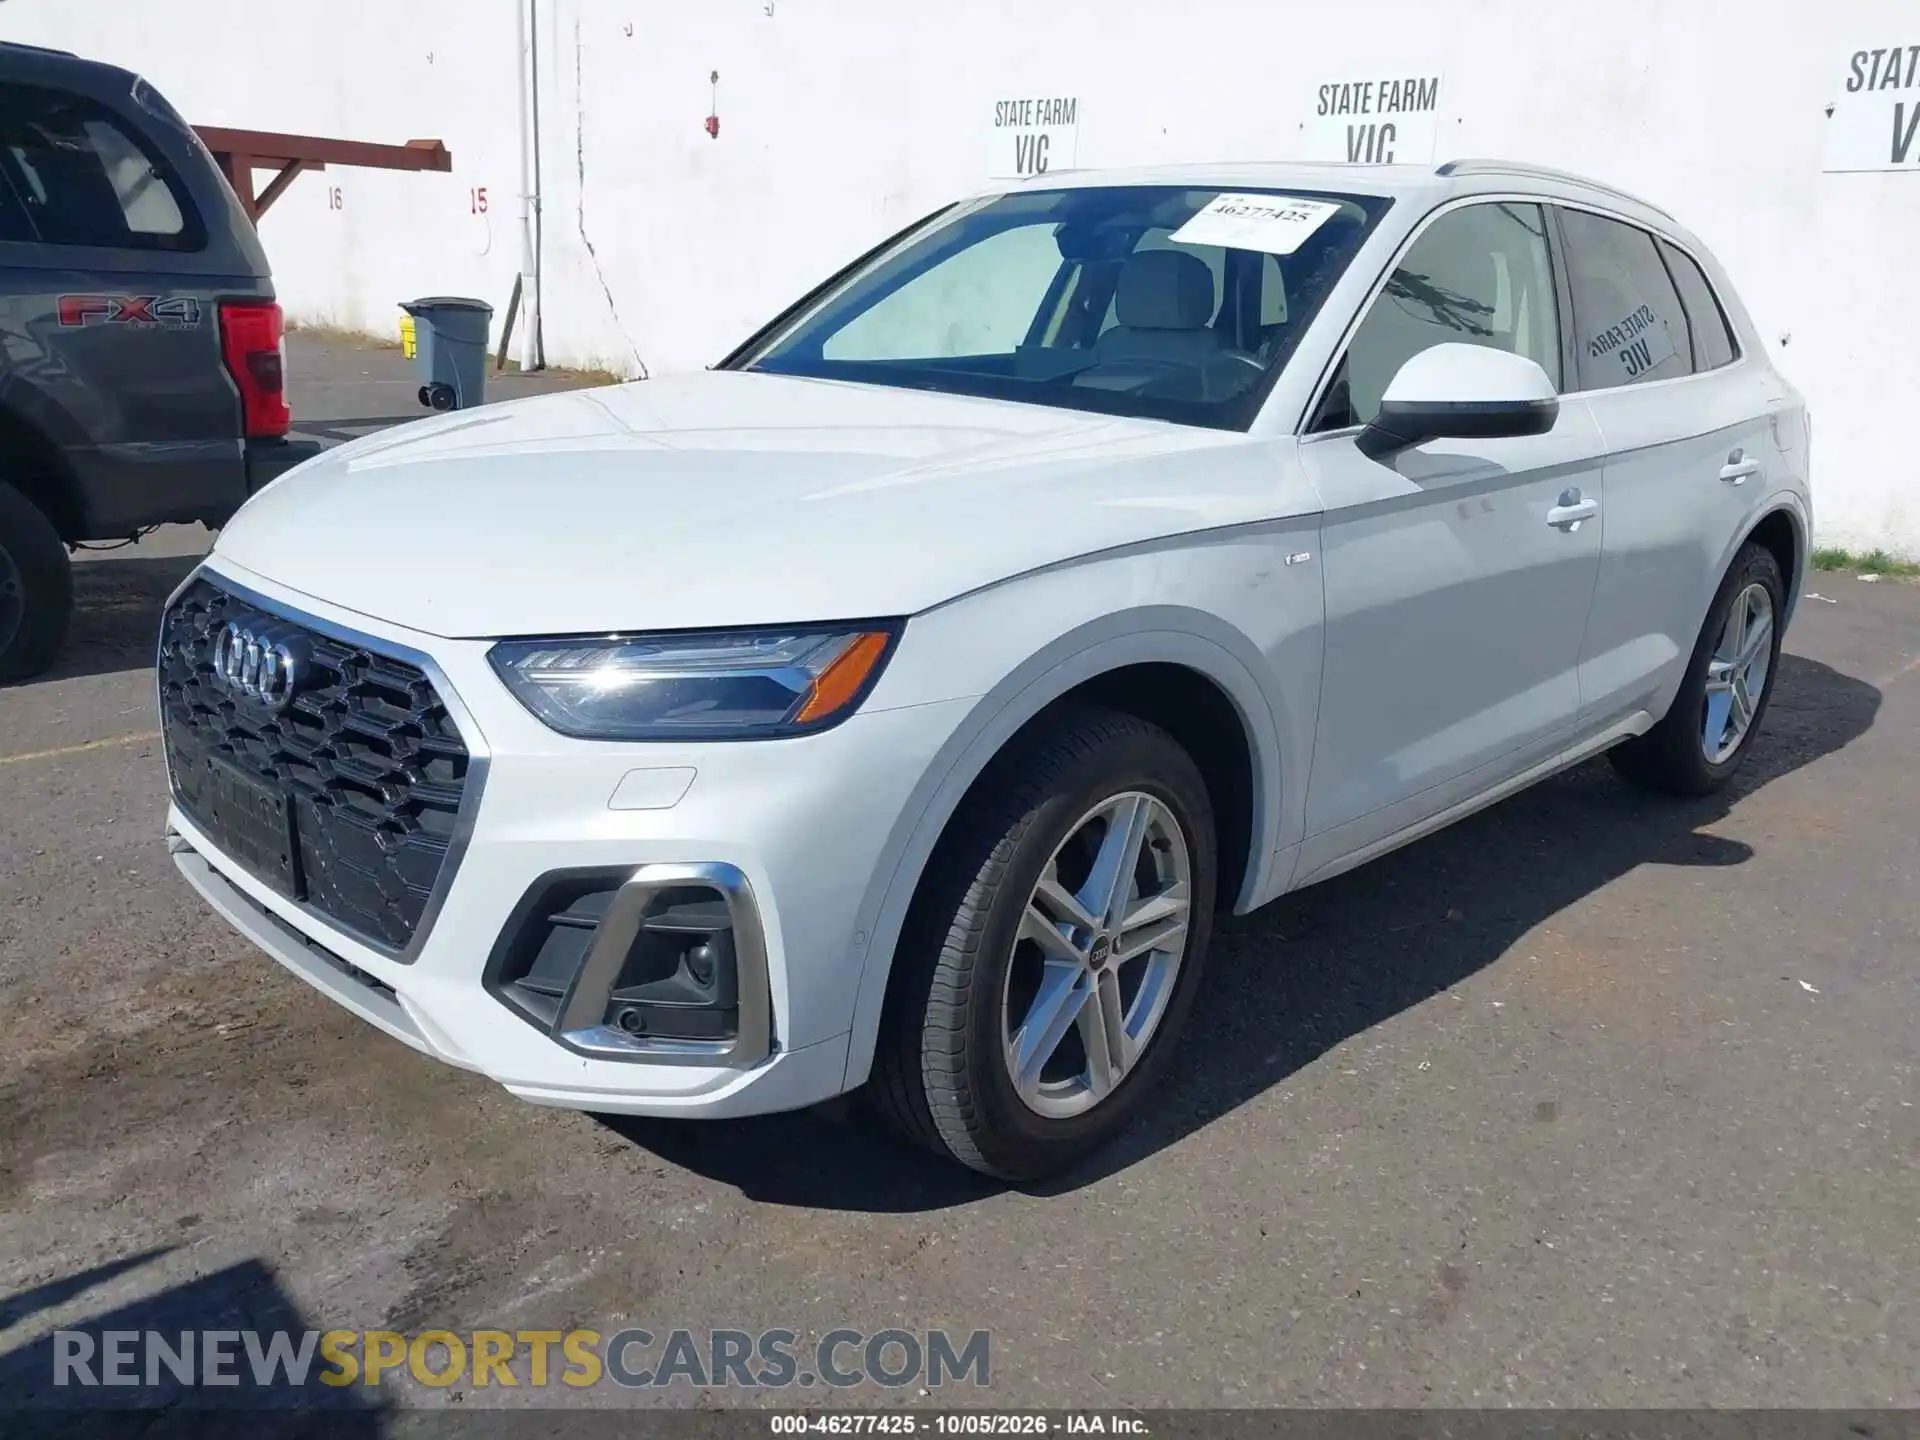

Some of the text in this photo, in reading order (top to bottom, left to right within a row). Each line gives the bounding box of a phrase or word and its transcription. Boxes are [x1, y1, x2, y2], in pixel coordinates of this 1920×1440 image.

[1846, 45, 1920, 92] STAT
[995, 97, 1077, 127] STATE FARM
[1317, 77, 1439, 116] STATE FARM
[1016, 133, 1049, 174] VIC
[1347, 122, 1396, 164] VIC
[329, 187, 342, 210] 16
[471, 187, 488, 214] 15
[1214, 205, 1312, 222] 46277425
[57, 293, 200, 327] FX4
